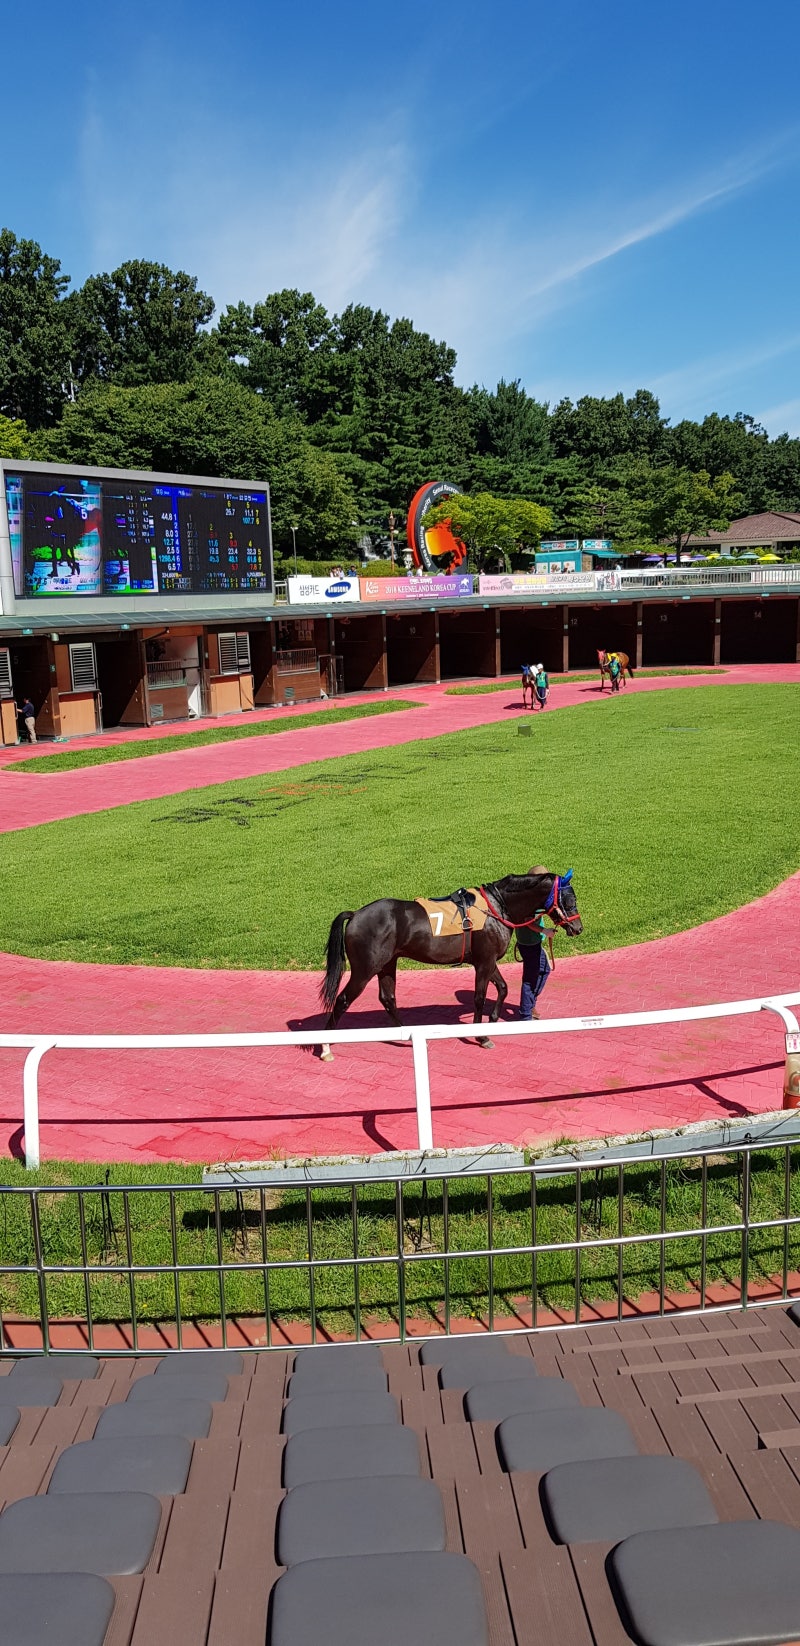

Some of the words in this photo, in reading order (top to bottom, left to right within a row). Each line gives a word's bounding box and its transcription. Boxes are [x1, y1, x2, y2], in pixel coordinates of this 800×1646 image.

[299, 584, 320, 596] 삼성카드
[397, 585, 428, 593] KEENELAND
[430, 584, 449, 592] KOREA
[430, 912, 443, 936] 7
